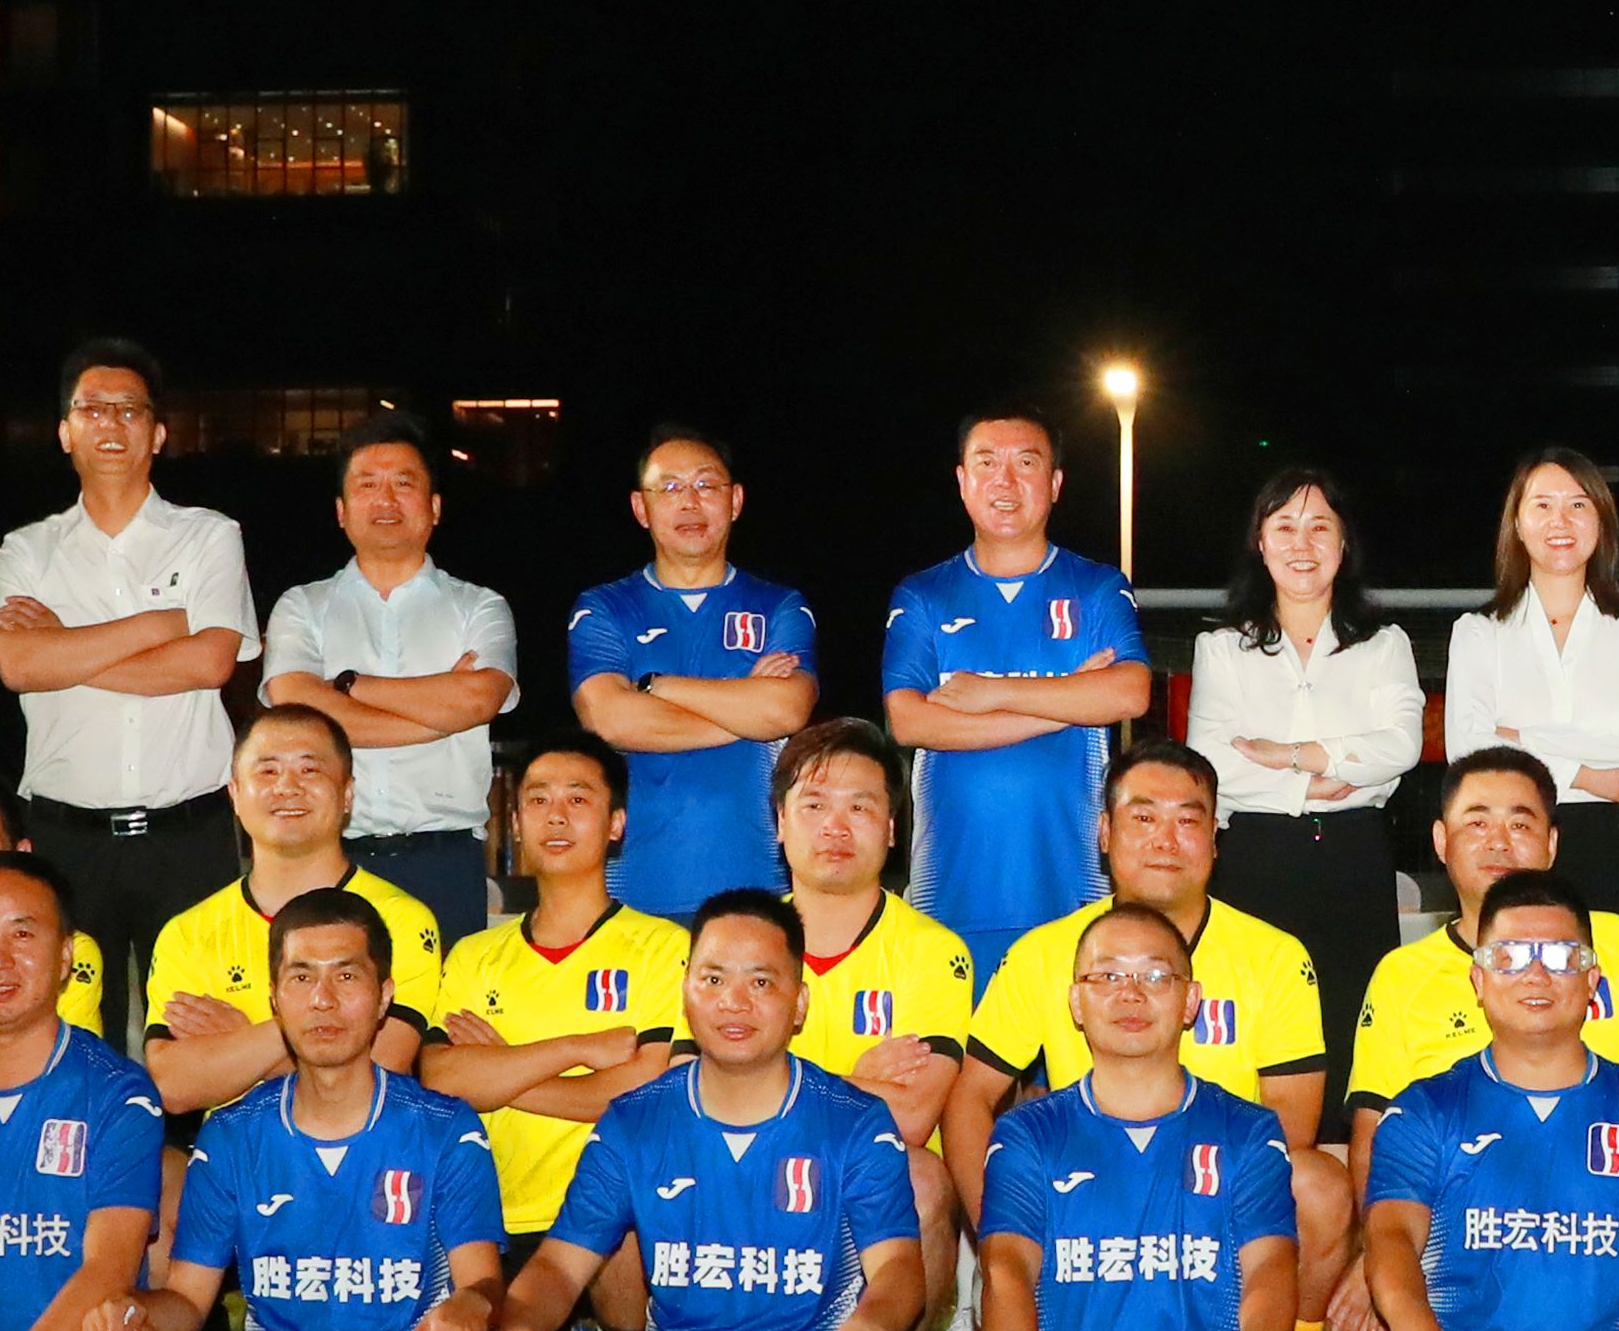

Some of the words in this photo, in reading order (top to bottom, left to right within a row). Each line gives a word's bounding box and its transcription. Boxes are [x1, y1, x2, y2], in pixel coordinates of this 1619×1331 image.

[226, 983, 251, 993] KELME
[1464, 1208, 1619, 1258] 胜宏科技
[251, 1254, 423, 1303] 胜宏科技
[651, 1241, 824, 1296] 胜宏科技
[1055, 1234, 1221, 1284] 胜宏科技
